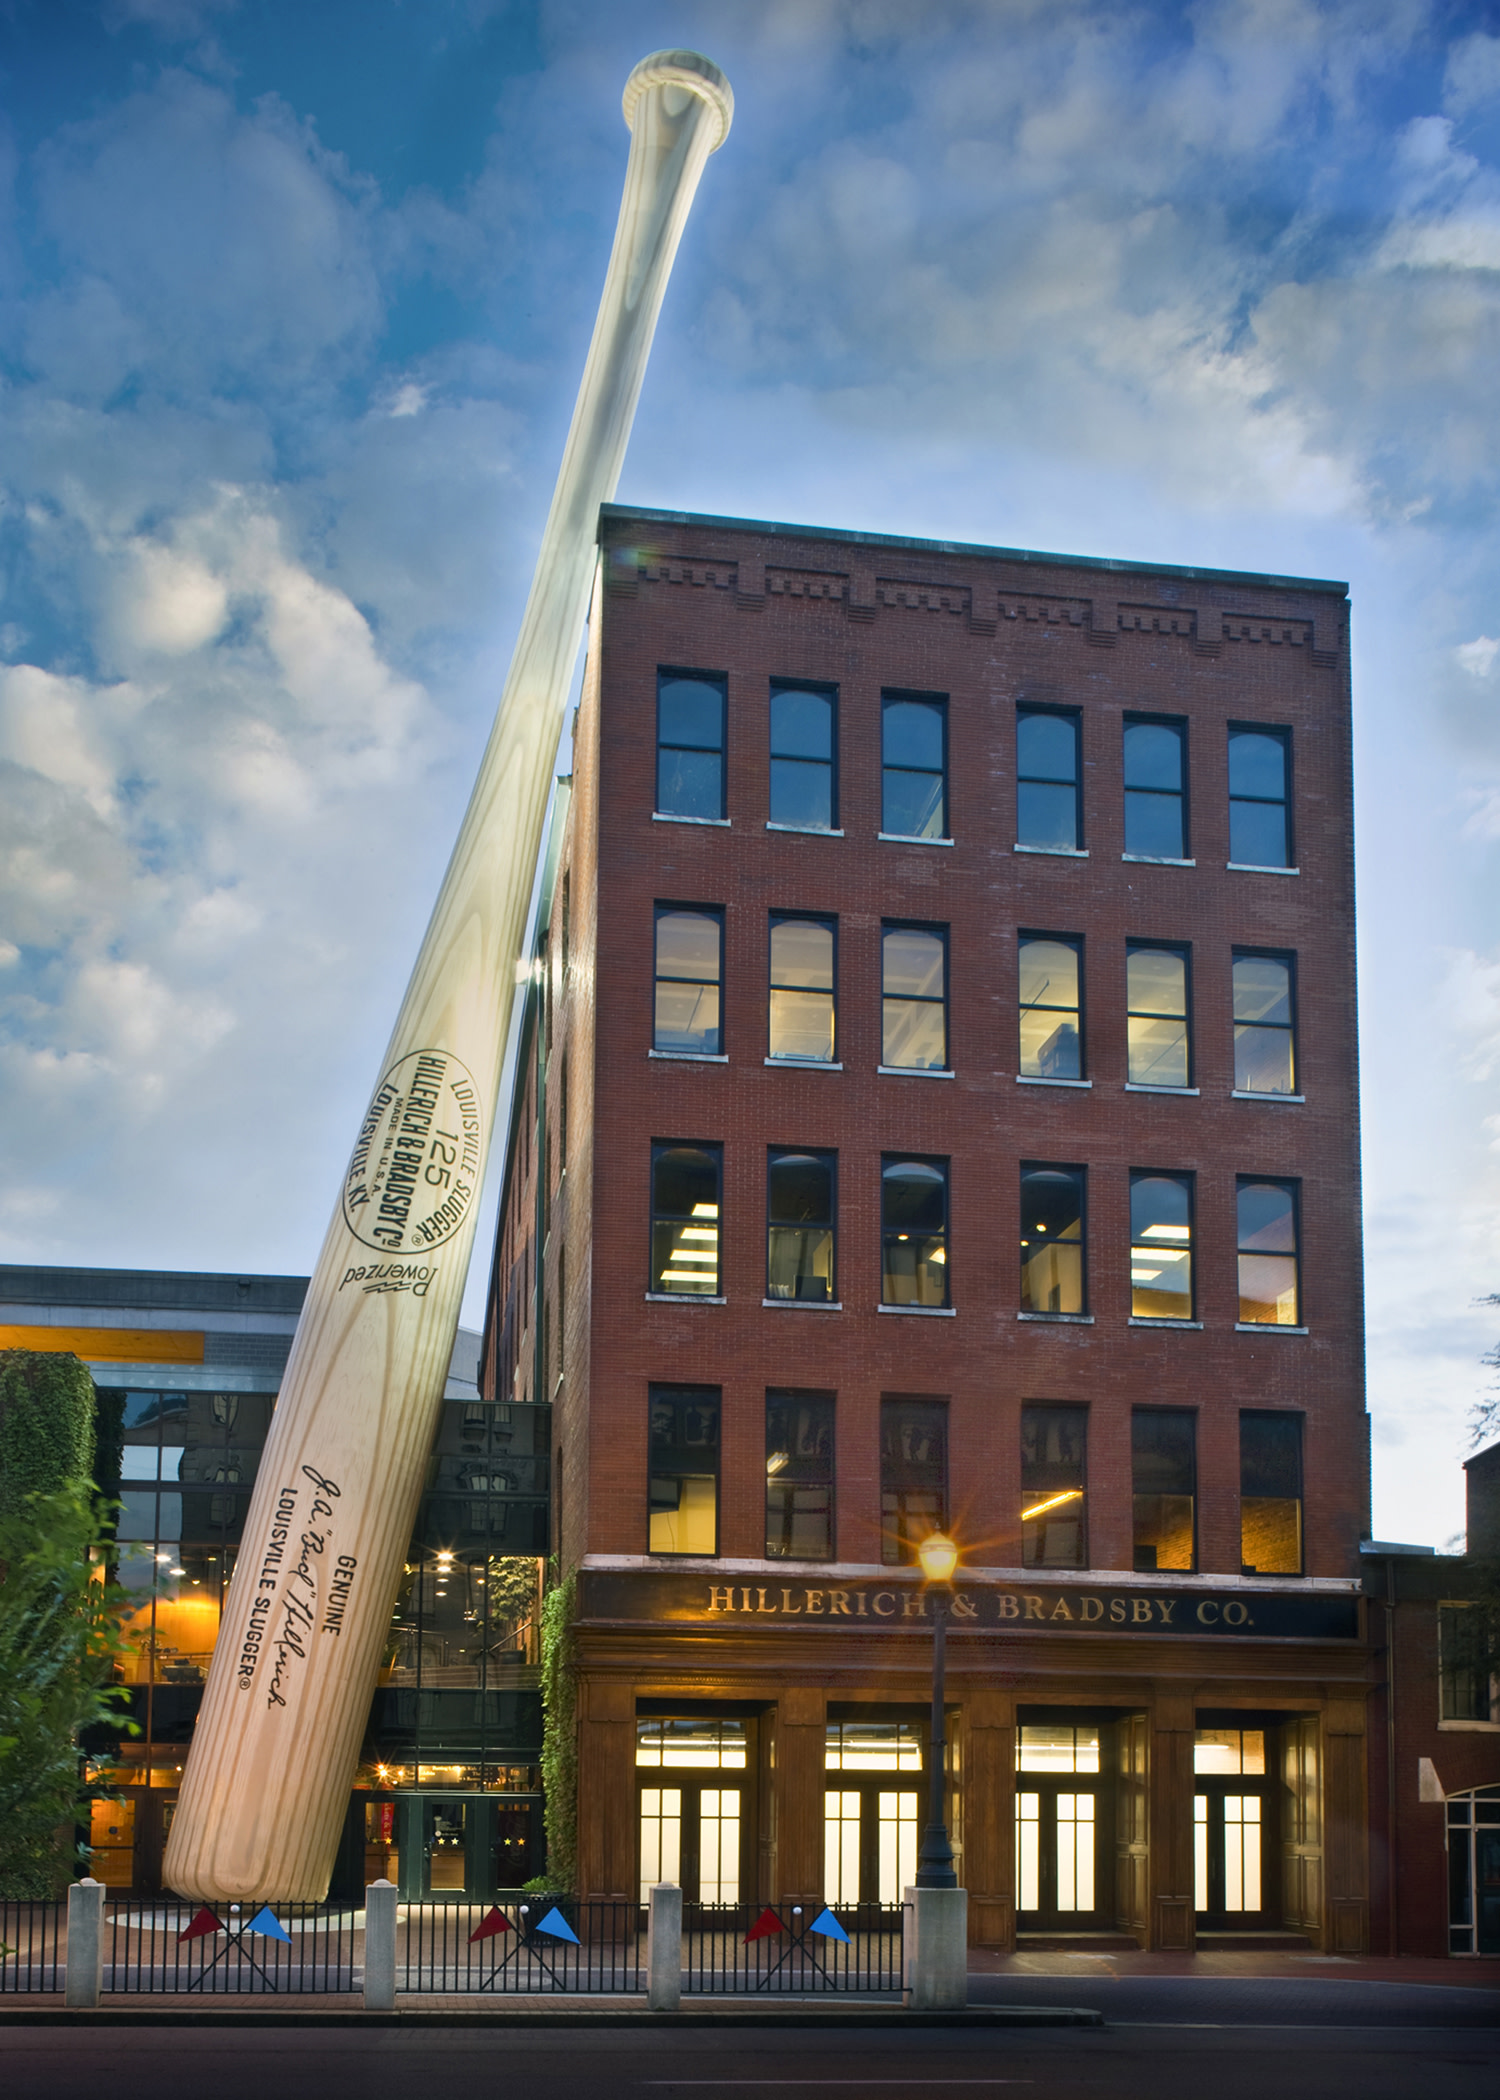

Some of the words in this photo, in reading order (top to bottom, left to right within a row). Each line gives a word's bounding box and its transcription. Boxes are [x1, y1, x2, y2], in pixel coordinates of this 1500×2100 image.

[387, 1097, 404, 1131] MADE
[400, 1055, 448, 1136] HILLERICH
[383, 1137, 394, 1150] IN
[396, 1136, 426, 1150] &
[425, 1128, 460, 1190] 125
[449, 1079, 479, 1179] LOUISVILLE
[376, 1150, 424, 1230] BRADSBY
[338, 1263, 439, 1297] Powerized
[258, 1487, 299, 1591] LOUISVILLE
[320, 1554, 358, 1637] GENUINE
[707, 1585, 929, 1618] HILLERICH
[950, 1593, 979, 1618] &
[996, 1594, 1177, 1625] BRADSBY
[1196, 1600, 1255, 1626] CO.
